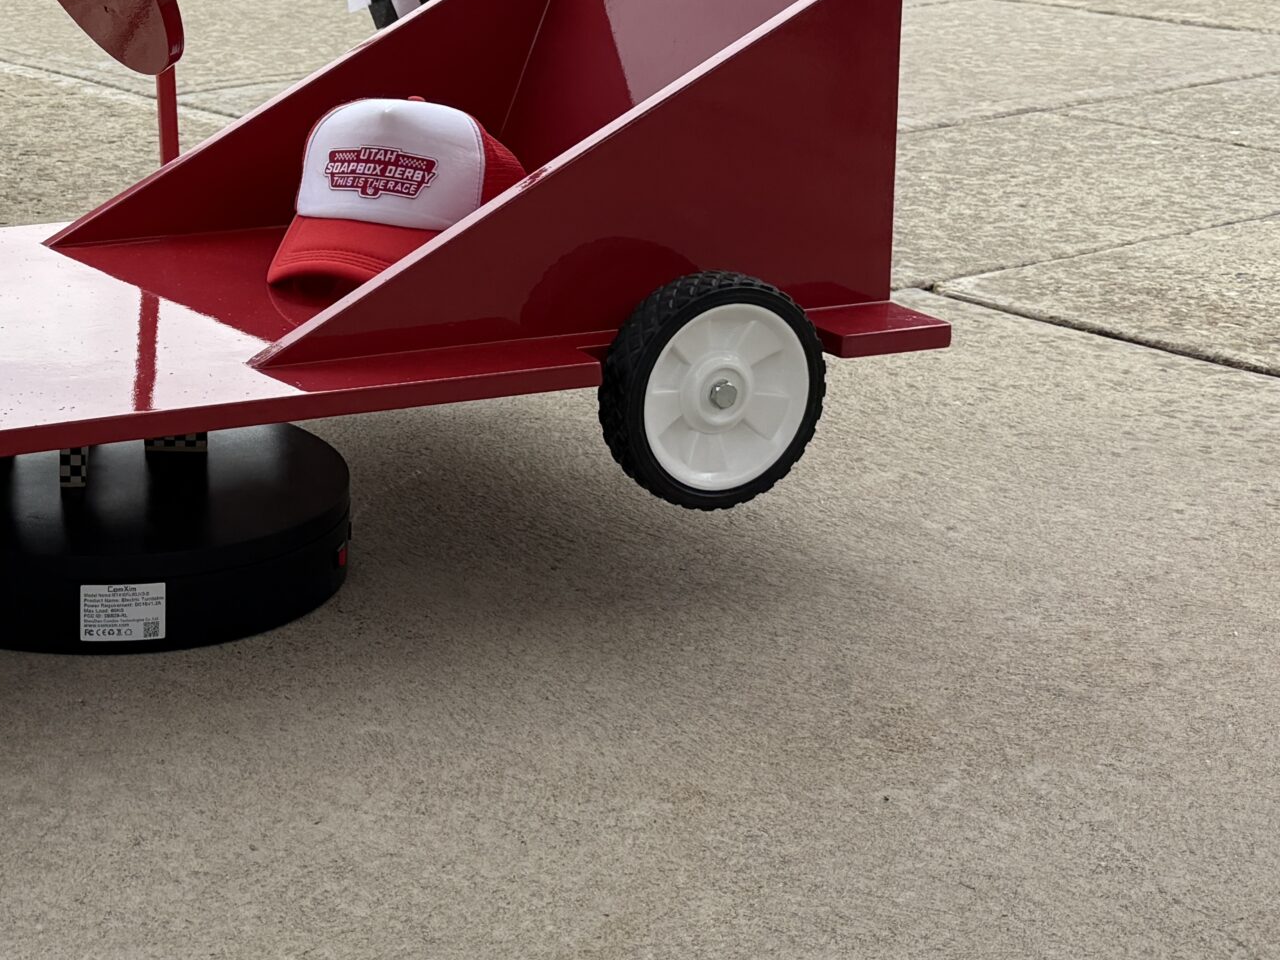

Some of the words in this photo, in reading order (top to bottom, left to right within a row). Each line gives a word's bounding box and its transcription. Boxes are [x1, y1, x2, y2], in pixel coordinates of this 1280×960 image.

[360, 148, 397, 162] UTAH
[325, 162, 384, 176] SOAPBOX
[384, 165, 434, 183] DERBY
[332, 176, 354, 186] THIS
[353, 177, 365, 187] IS
[367, 178, 386, 189] THE
[386, 180, 418, 194] RACE
